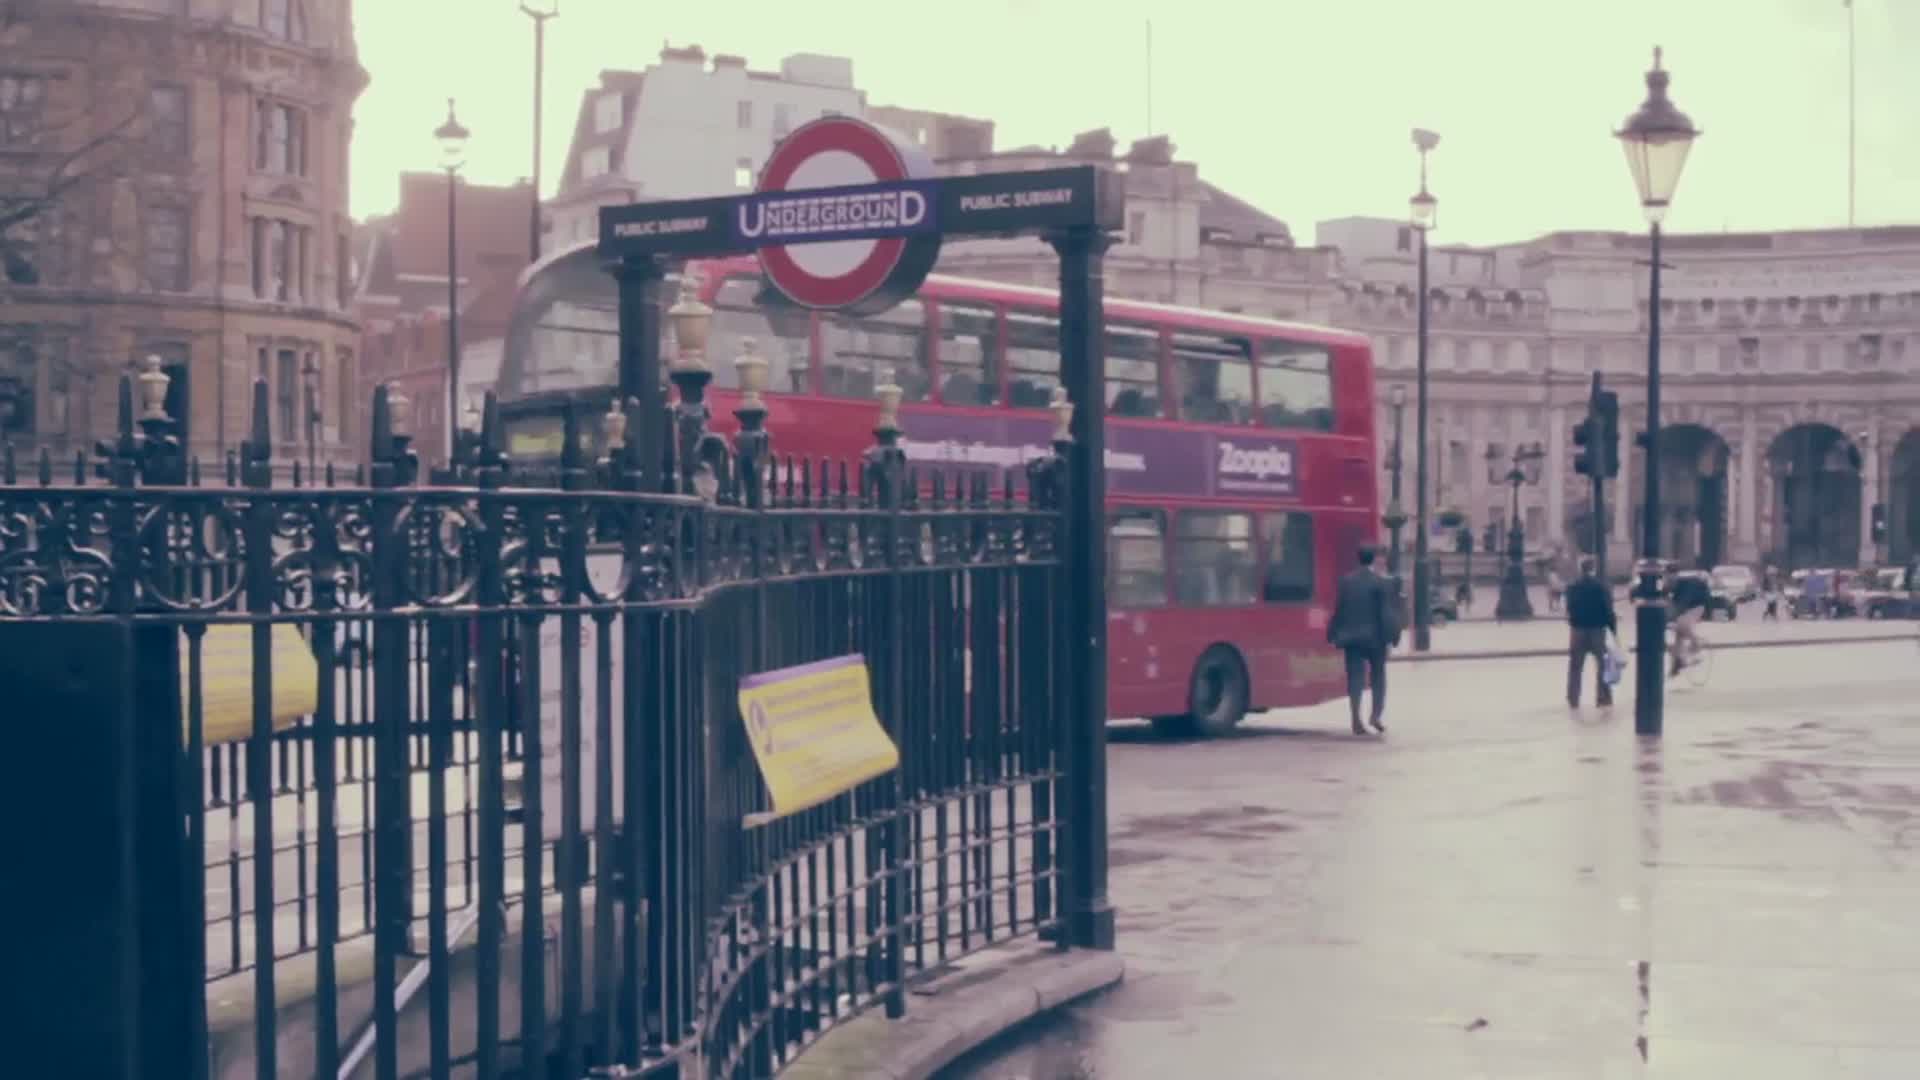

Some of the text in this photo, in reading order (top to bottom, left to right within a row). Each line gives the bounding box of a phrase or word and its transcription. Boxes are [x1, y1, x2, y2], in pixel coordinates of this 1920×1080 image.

[739, 190, 926, 238] UNDERGROUND
[960, 188, 1072, 212] PUBLIC SUBWAY
[614, 216, 708, 237] PUBLIC SUBWAY
[1219, 442, 1292, 479] Zoopla
